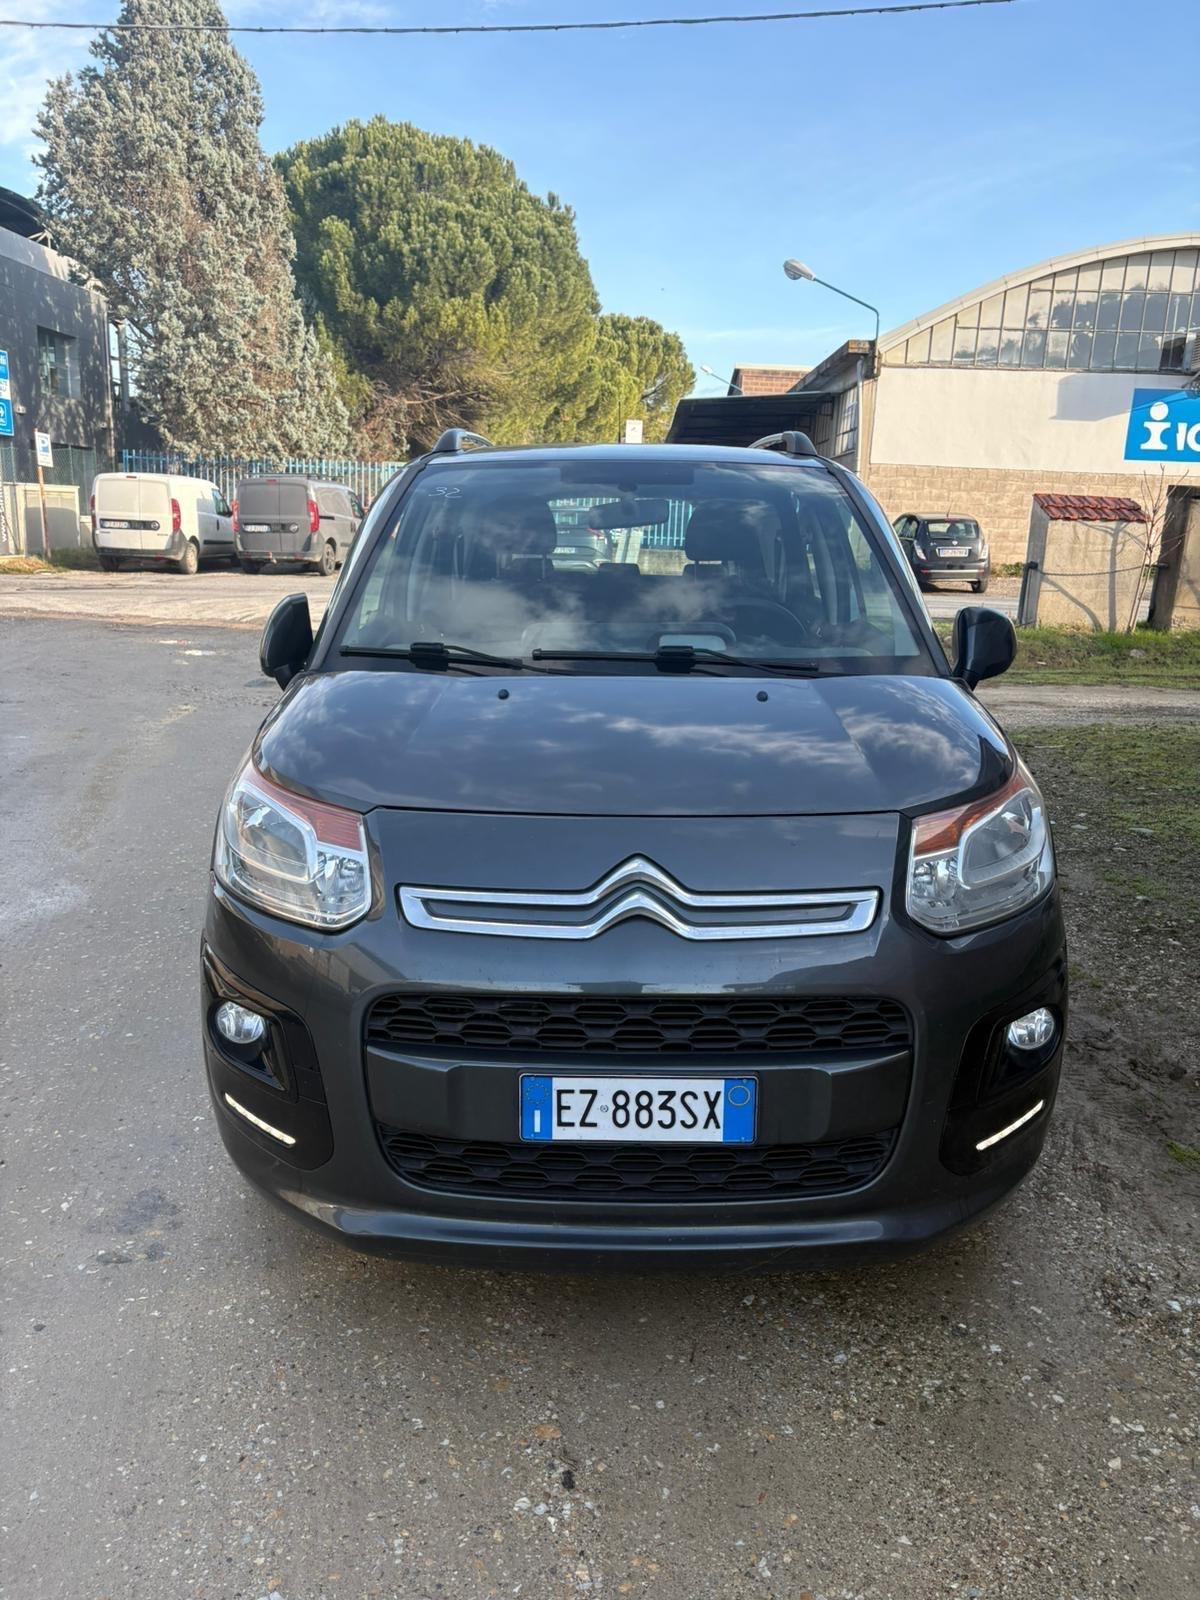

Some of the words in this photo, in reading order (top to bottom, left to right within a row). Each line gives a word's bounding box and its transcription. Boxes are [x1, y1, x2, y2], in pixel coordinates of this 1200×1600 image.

[428, 487, 462, 498] 32
[555, 1089, 598, 1128] EZ
[611, 1089, 721, 1130] 883SX
